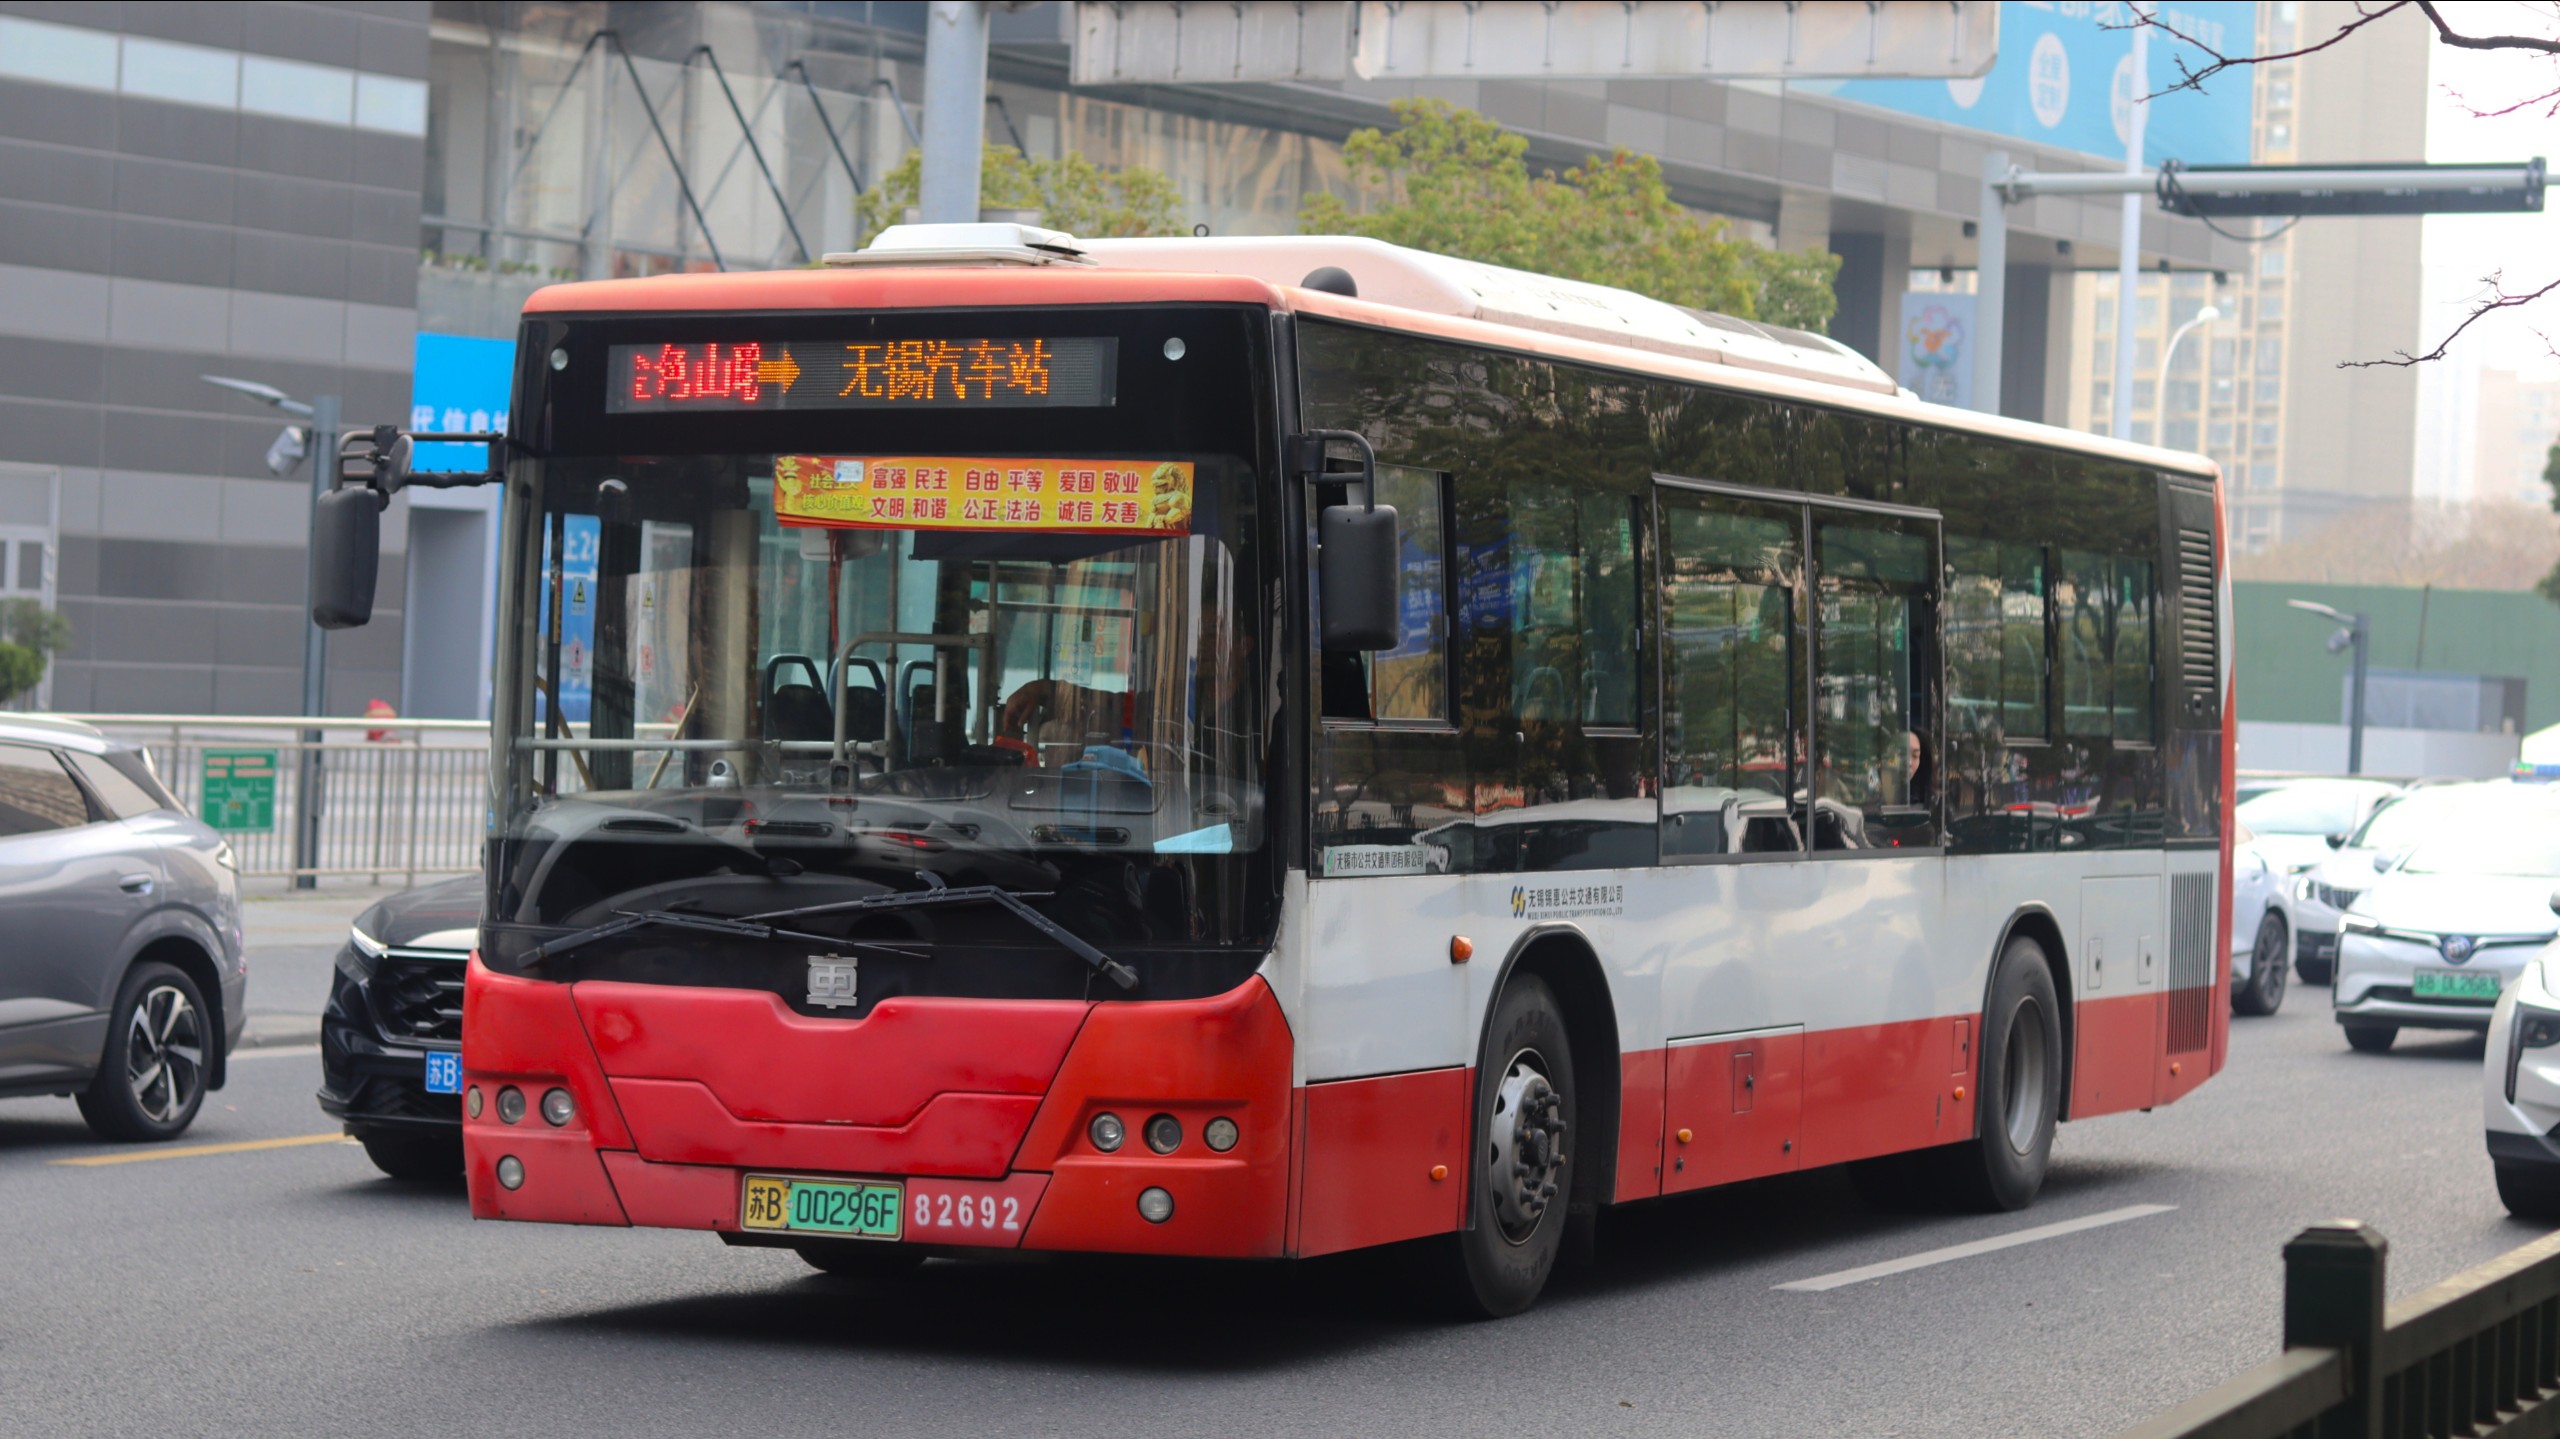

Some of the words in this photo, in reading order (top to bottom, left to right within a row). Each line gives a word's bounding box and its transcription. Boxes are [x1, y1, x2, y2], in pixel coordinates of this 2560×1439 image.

[838, 339, 1053, 400] 无锡汽车站
[872, 467, 906, 490] 富强
[914, 468, 948, 490] 民主
[965, 469, 1000, 491] 自由
[1007, 470, 1043, 493] 平等
[1059, 471, 1095, 494] 爱国
[1103, 471, 1139, 494] 敬业
[802, 494, 865, 511] 核心价值观
[870, 497, 905, 519] 文明
[912, 497, 948, 519] 和谐
[963, 499, 998, 521] 公正
[1006, 499, 1041, 522] 法治
[1058, 500, 1094, 523] 诚信
[1101, 501, 1138, 524] 友善
[1336, 850, 1424, 870] 无锡市公共交通集团有限公司
[1528, 886, 1623, 908] 无锡锡惠公共交通有限公司
[796, 1188, 898, 1228] 00296F
[914, 1193, 1020, 1230] 82692
